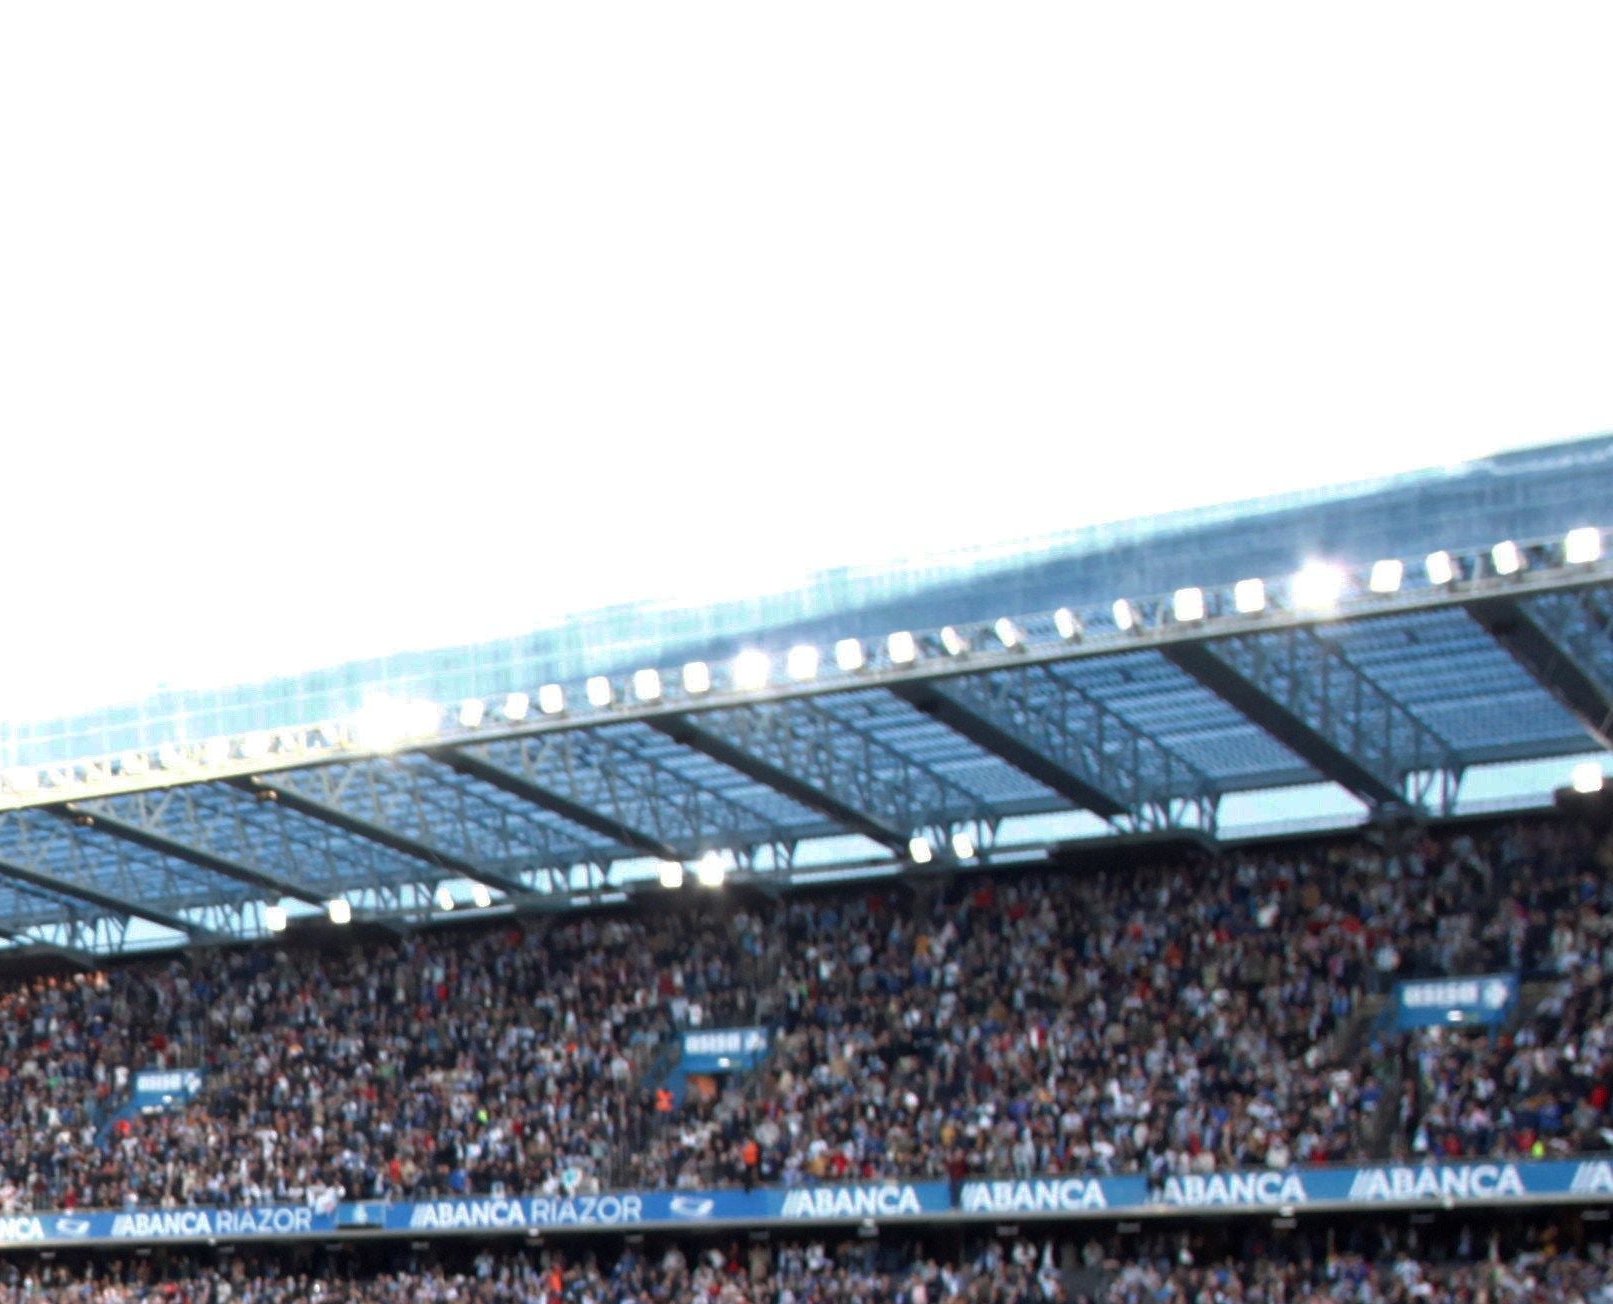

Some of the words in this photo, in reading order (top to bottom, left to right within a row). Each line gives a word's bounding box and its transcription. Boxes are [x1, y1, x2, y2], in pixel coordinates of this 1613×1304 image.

[973, 1178, 1108, 1210] ABANCA
[1163, 1172, 1307, 1205] ABANCA
[1369, 1163, 1525, 1198] ABANCA
[421, 1199, 525, 1228] ABANCA
[530, 1195, 642, 1225] RIAZOR
[793, 1186, 921, 1217] ABANCA
[120, 1210, 213, 1236] ABANCA
[216, 1206, 312, 1233] RIAZOR
